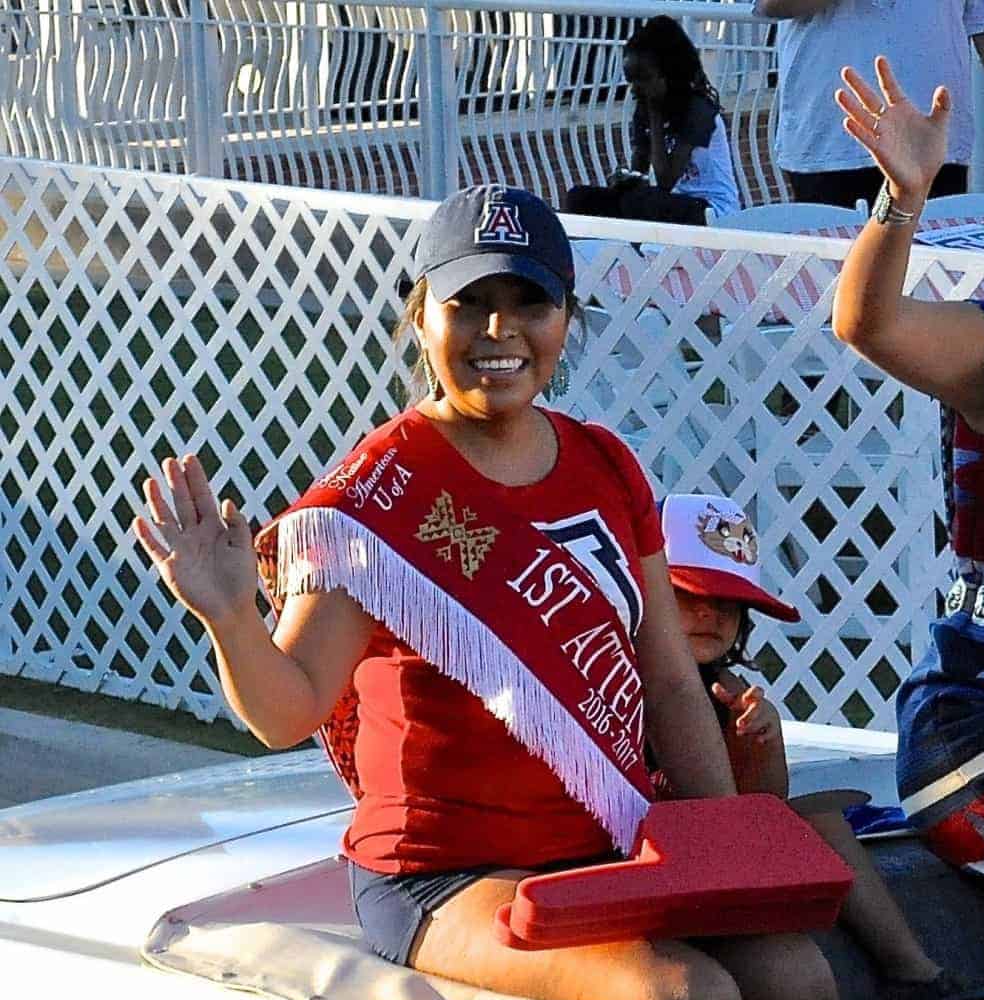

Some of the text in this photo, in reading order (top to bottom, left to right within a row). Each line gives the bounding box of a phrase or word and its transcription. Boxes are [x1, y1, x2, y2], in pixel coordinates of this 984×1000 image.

[474, 201, 529, 246] A
[346, 447, 399, 509] American
[373, 463, 413, 511] U of A
[506, 548, 592, 627] 1ST
